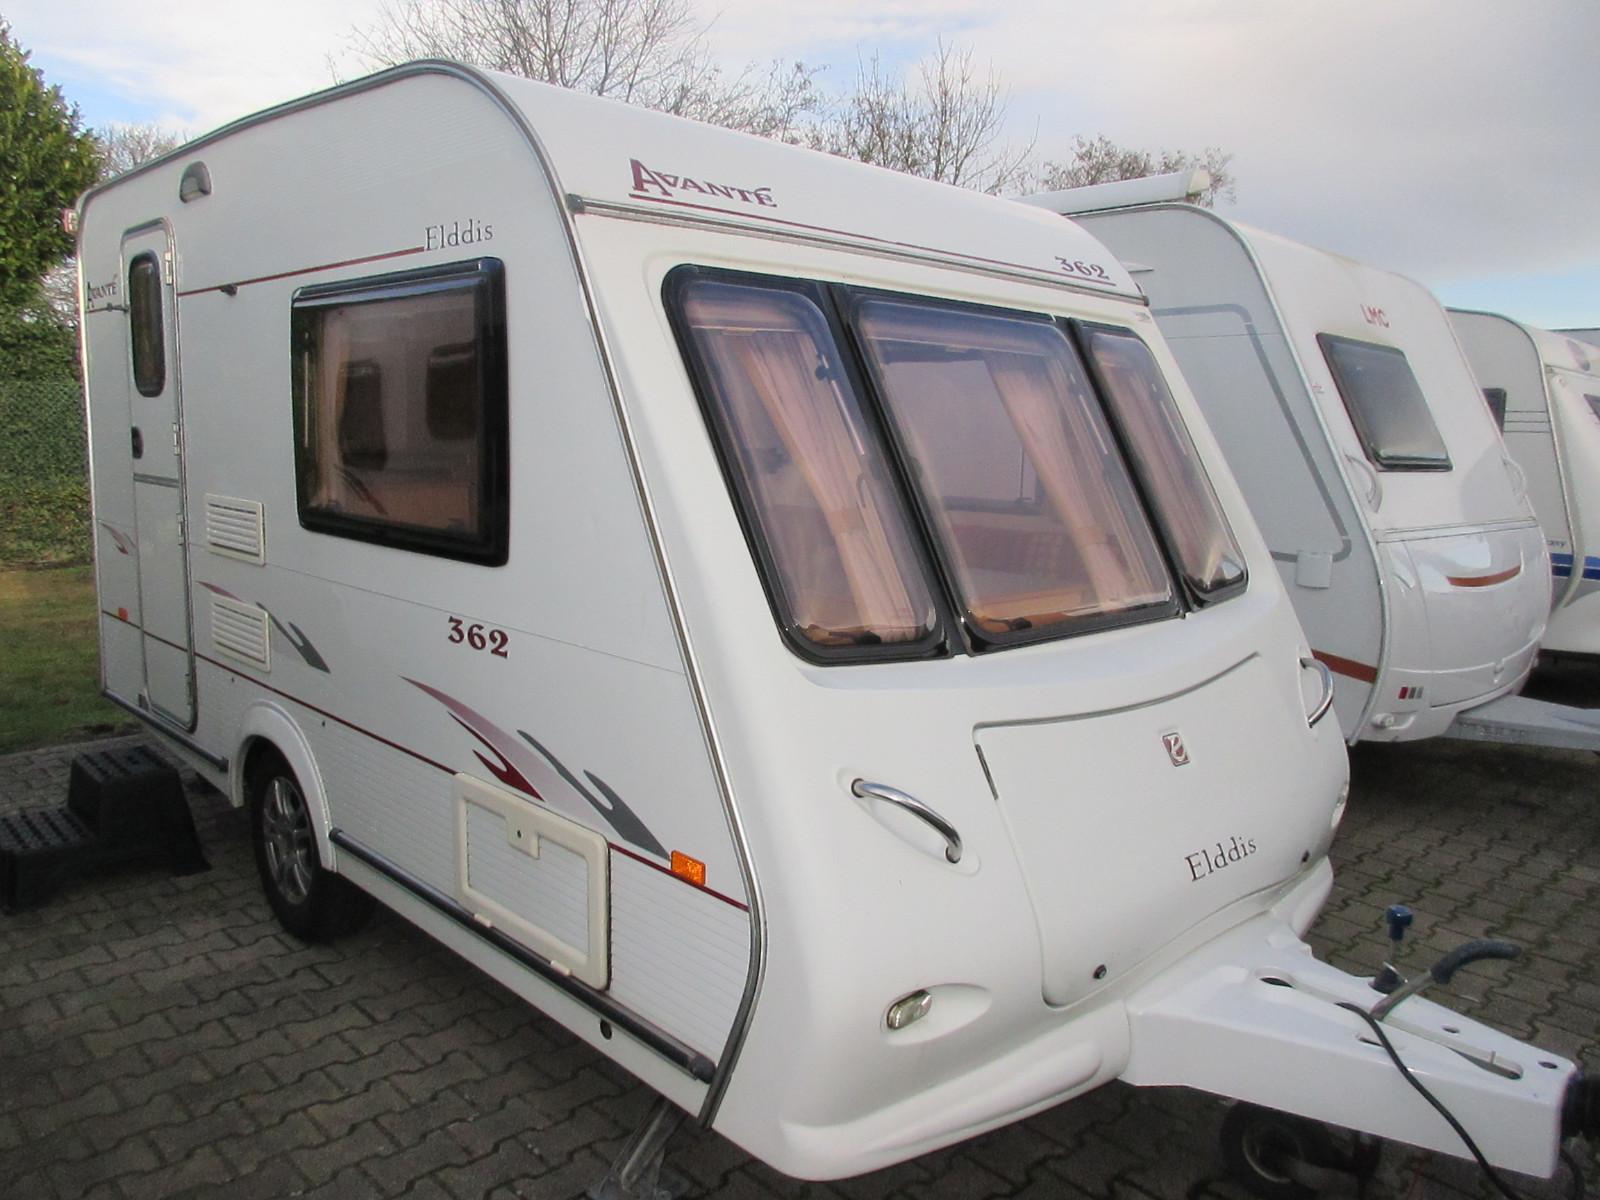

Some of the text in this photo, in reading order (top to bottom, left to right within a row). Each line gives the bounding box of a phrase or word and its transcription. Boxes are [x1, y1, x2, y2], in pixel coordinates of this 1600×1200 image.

[425, 219, 493, 251] Elddis
[1055, 256, 1110, 279] 362
[1360, 304, 1390, 328] LMC
[448, 615, 508, 659] 362
[1184, 836, 1257, 882] Elddis
